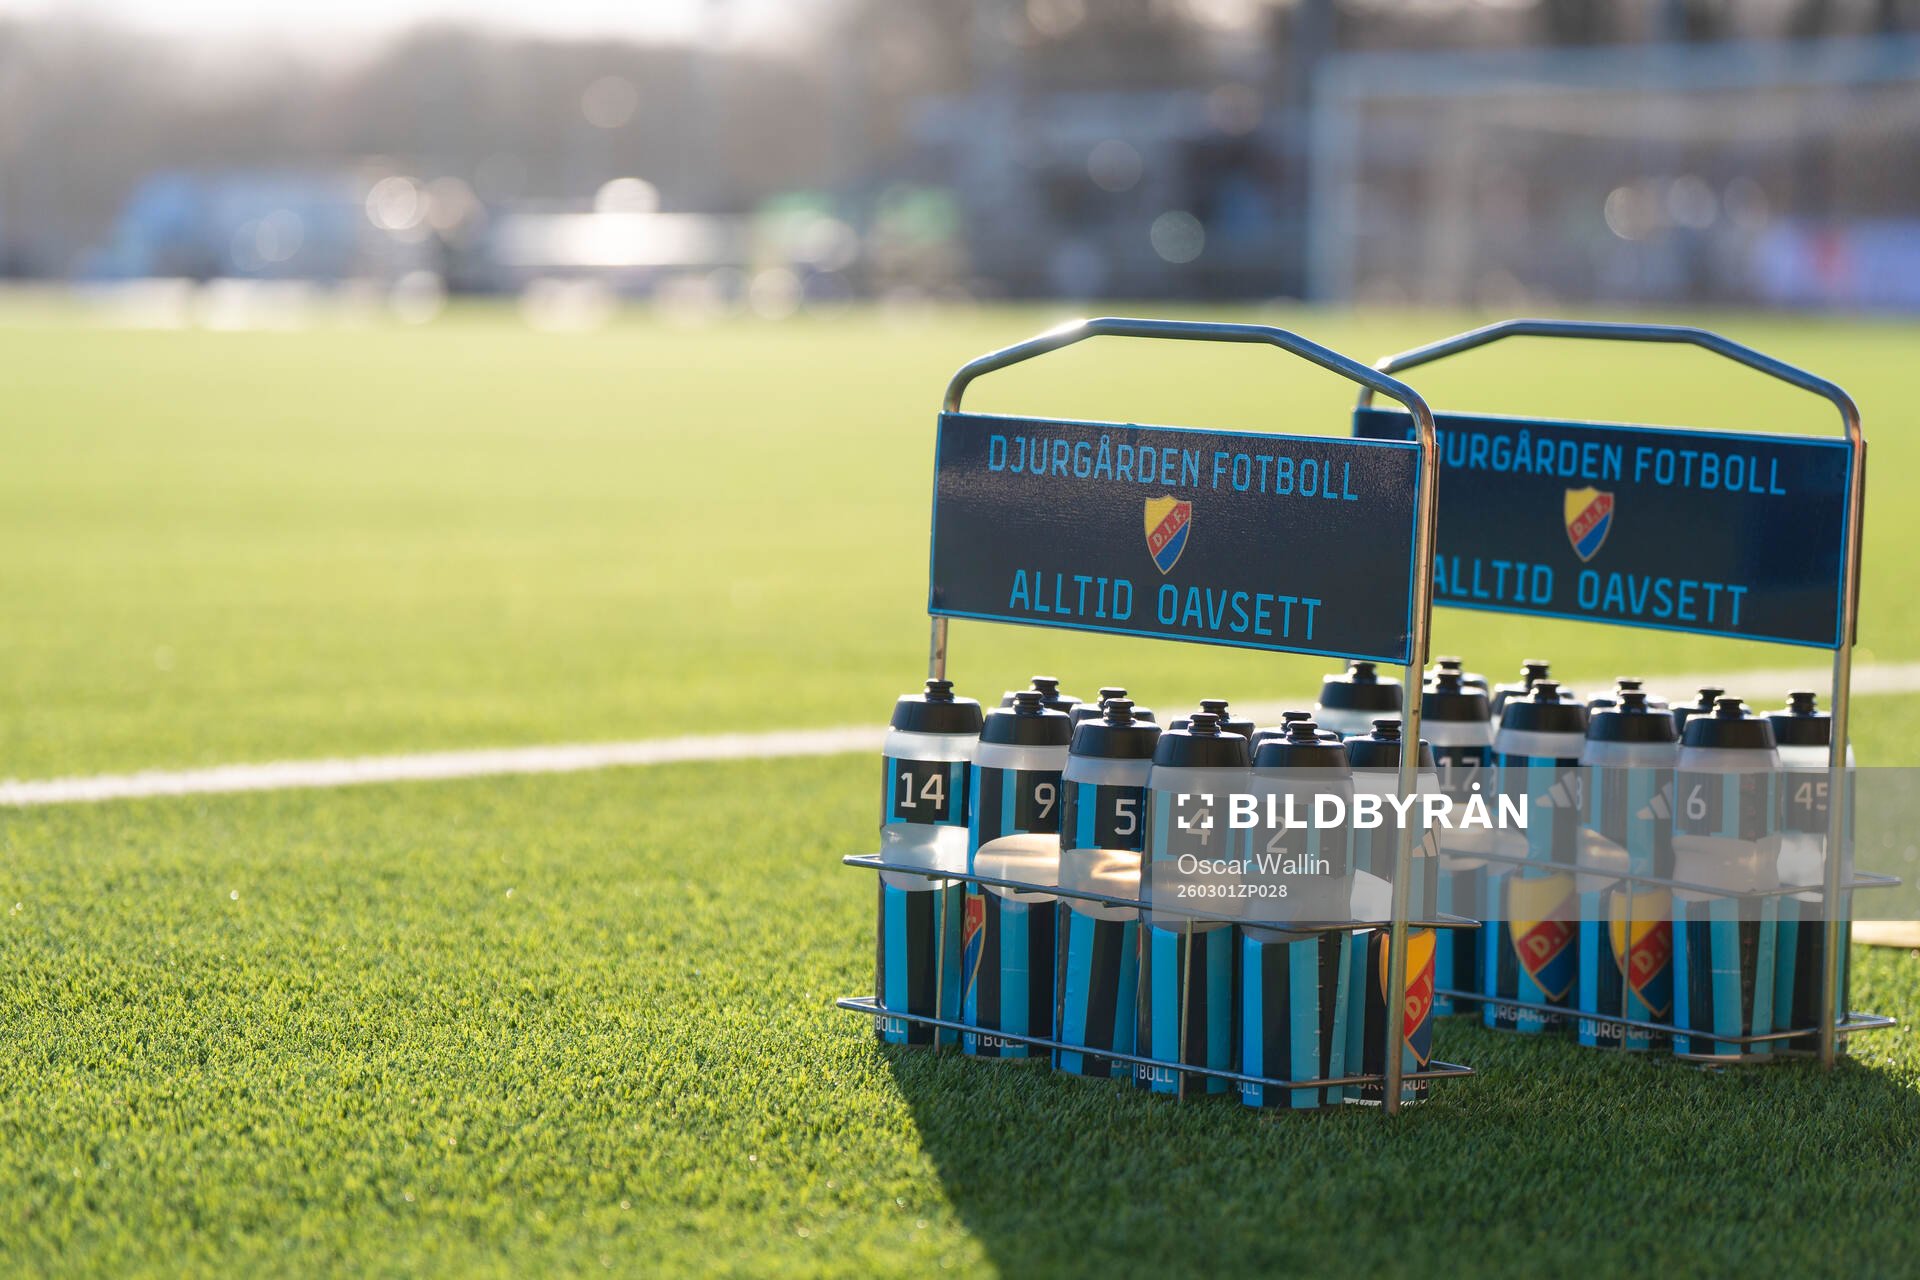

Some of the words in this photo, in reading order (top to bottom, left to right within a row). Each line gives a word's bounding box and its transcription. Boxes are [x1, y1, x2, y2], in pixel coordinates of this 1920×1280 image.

[988, 433, 1200, 489] DJURGÅRDEN
[1212, 451, 1359, 501] FOTBOLL
[1407, 427, 1623, 482] URGÅRDEN
[1634, 446, 1787, 496] FOTBOLL
[1152, 509, 1187, 548] D.I.F.
[1009, 568, 1134, 622] ALLTID
[1156, 583, 1322, 642] OAVSETT
[1434, 553, 1554, 603] ALLTID
[1577, 568, 1748, 626] OAVSETT
[900, 772, 945, 811] 14
[1438, 756, 1481, 793] 17
[1034, 782, 1056, 820] 9
[1113, 798, 1137, 836] 5
[1686, 784, 1707, 821] 6
[1185, 808, 1212, 846] 4
[1264, 815, 1289, 855] 2
